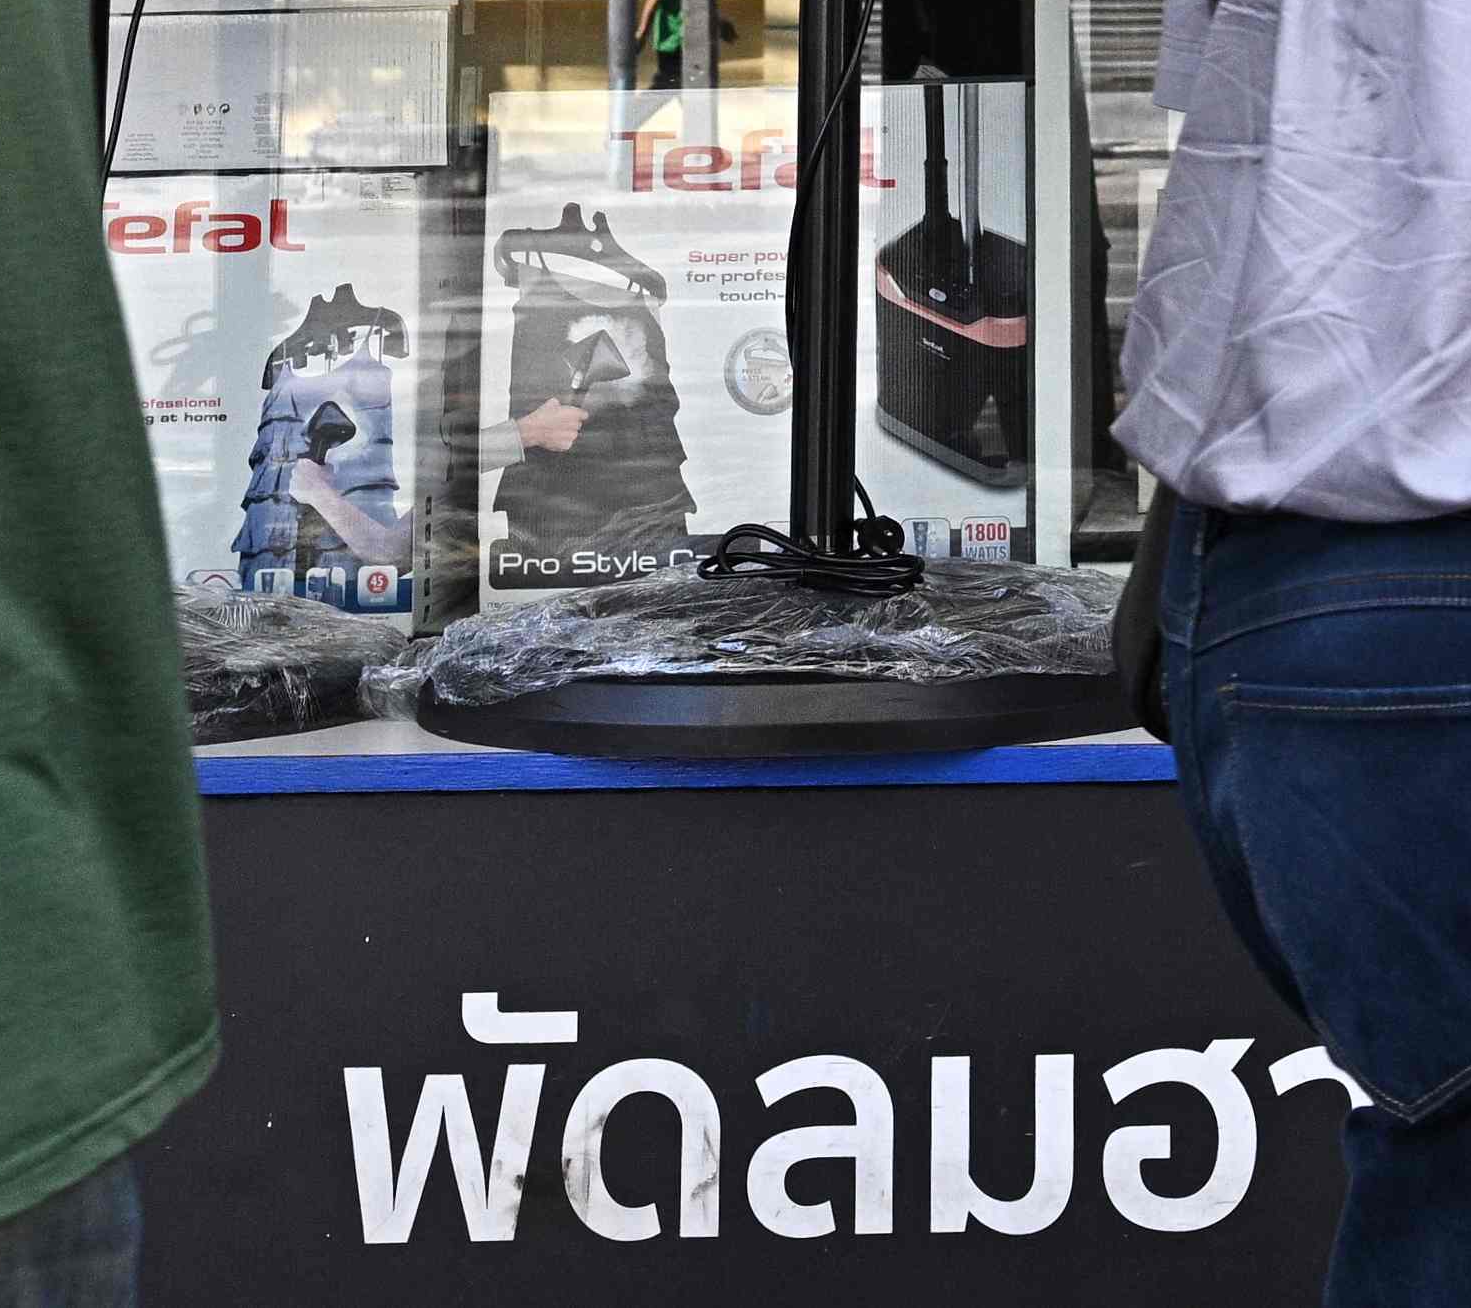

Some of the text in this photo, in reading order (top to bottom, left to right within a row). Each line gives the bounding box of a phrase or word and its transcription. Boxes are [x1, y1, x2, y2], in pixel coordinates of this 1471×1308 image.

[688, 250, 749, 267] Super
[686, 269, 716, 284] for
[161, 411, 228, 424] at home
[964, 522, 1008, 543] 1800
[965, 546, 1008, 562] WATTS
[498, 550, 657, 579] Pro Style
[369, 574, 386, 588] 45
